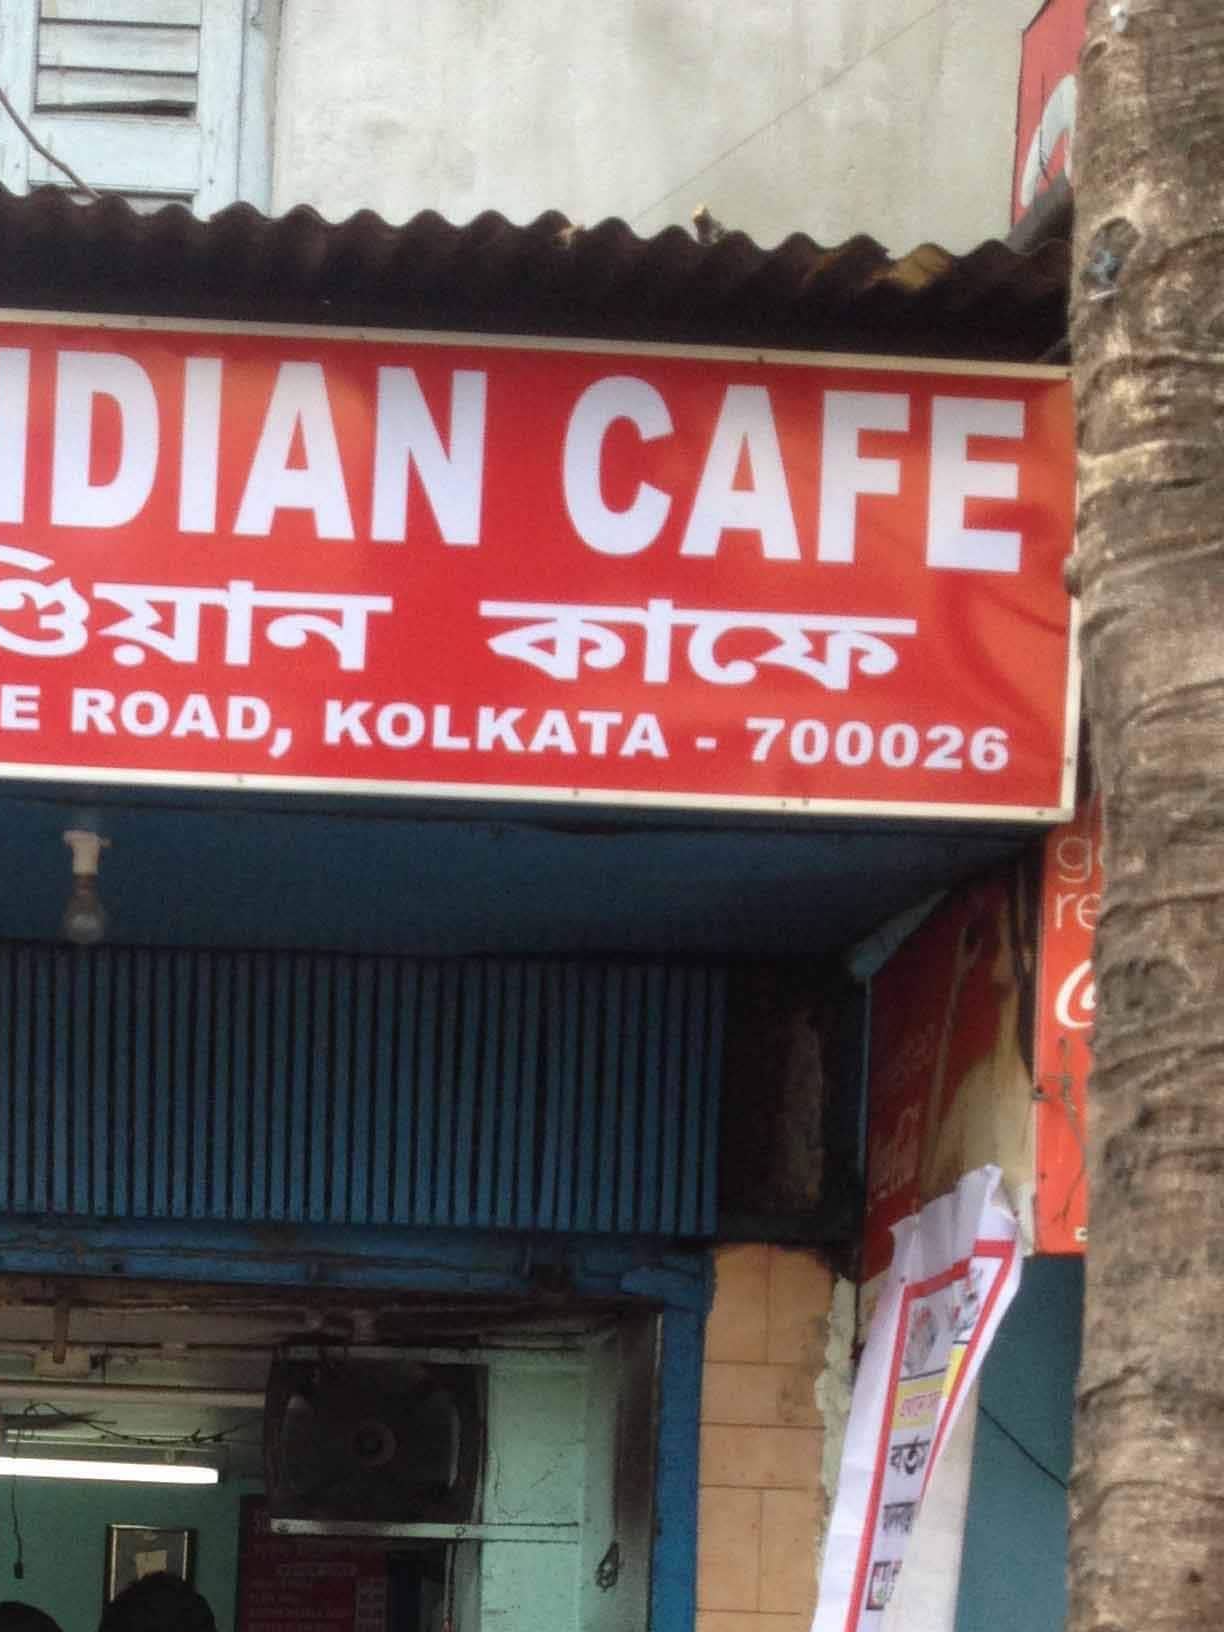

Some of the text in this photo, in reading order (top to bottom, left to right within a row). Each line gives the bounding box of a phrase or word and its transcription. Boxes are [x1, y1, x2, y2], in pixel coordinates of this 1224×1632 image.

[562, 375, 1026, 573] CAFE
[479, 599, 917, 691] কাফে
[71, 689, 293, 758] ROAD,
[324, 699, 670, 759] KOLKATA
[746, 717, 1011, 772] 700026
